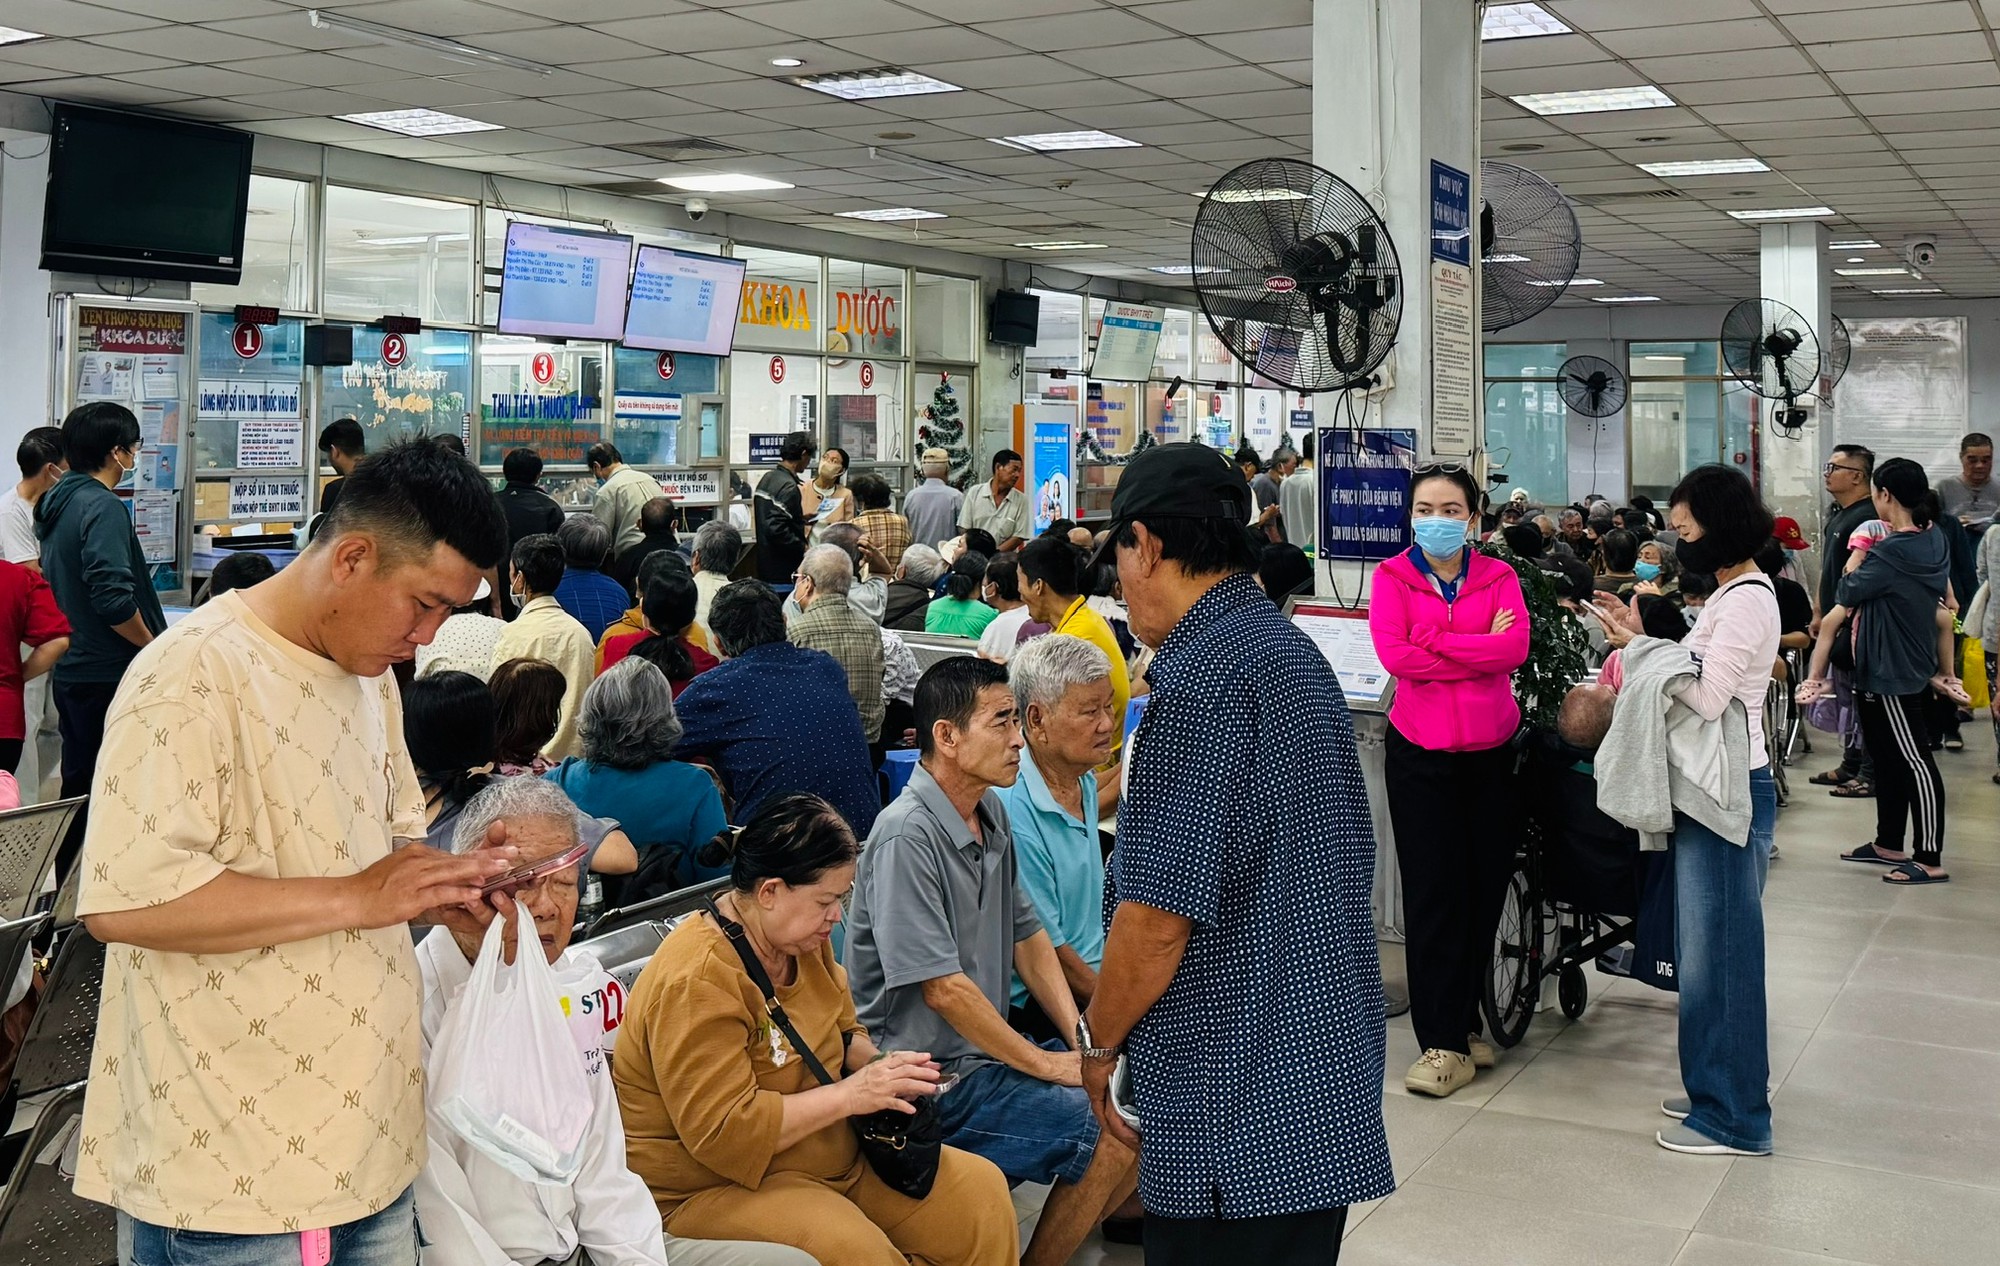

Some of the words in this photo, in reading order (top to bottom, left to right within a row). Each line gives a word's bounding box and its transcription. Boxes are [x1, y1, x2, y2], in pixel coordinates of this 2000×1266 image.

[1439, 173, 1451, 192] KHU
[1451, 178, 1463, 199] VỰC
[741, 281, 811, 331] KHOA
[836, 287, 896, 345] DƯỢC
[243, 329, 255, 351] 1
[388, 339, 401, 359] 2
[538, 355, 549, 380] 3
[662, 357, 672, 374] 4
[773, 362, 782, 378] 5
[863, 367, 871, 383] 6
[238, 390, 246, 412] VÀ
[247, 394, 257, 412] TOA
[492, 393, 511, 418] THU
[514, 383, 535, 418] TIỀN
[538, 386, 568, 419] THUỐC
[570, 395, 593, 420] BHYT
[673, 473, 686, 483] LẠI
[687, 471, 697, 481] HỒ
[698, 473, 708, 482] SƠ
[692, 484, 702, 493] TAY
[703, 481, 716, 493] PHẢI
[234, 481, 247, 499] NỘP
[258, 481, 266, 496] VÀ
[267, 484, 279, 496] TOA
[280, 479, 299, 496] THUỐC
[1339, 489, 1353, 507] PHỤC
[1389, 487, 1402, 509] VIỆN
[1332, 526, 1341, 540] XIN
[1342, 526, 1351, 540] VUI
[1379, 524, 1389, 542] VÀO
[206, 970, 225, 991] NY
[304, 973, 322, 993] NY
[351, 1006, 367, 1027] NY
[248, 1018, 267, 1037] NY
[295, 1054, 314, 1073] NY
[343, 1089, 361, 1109] NY
[286, 1135, 305, 1155] NY
[233, 1175, 254, 1196] NY
